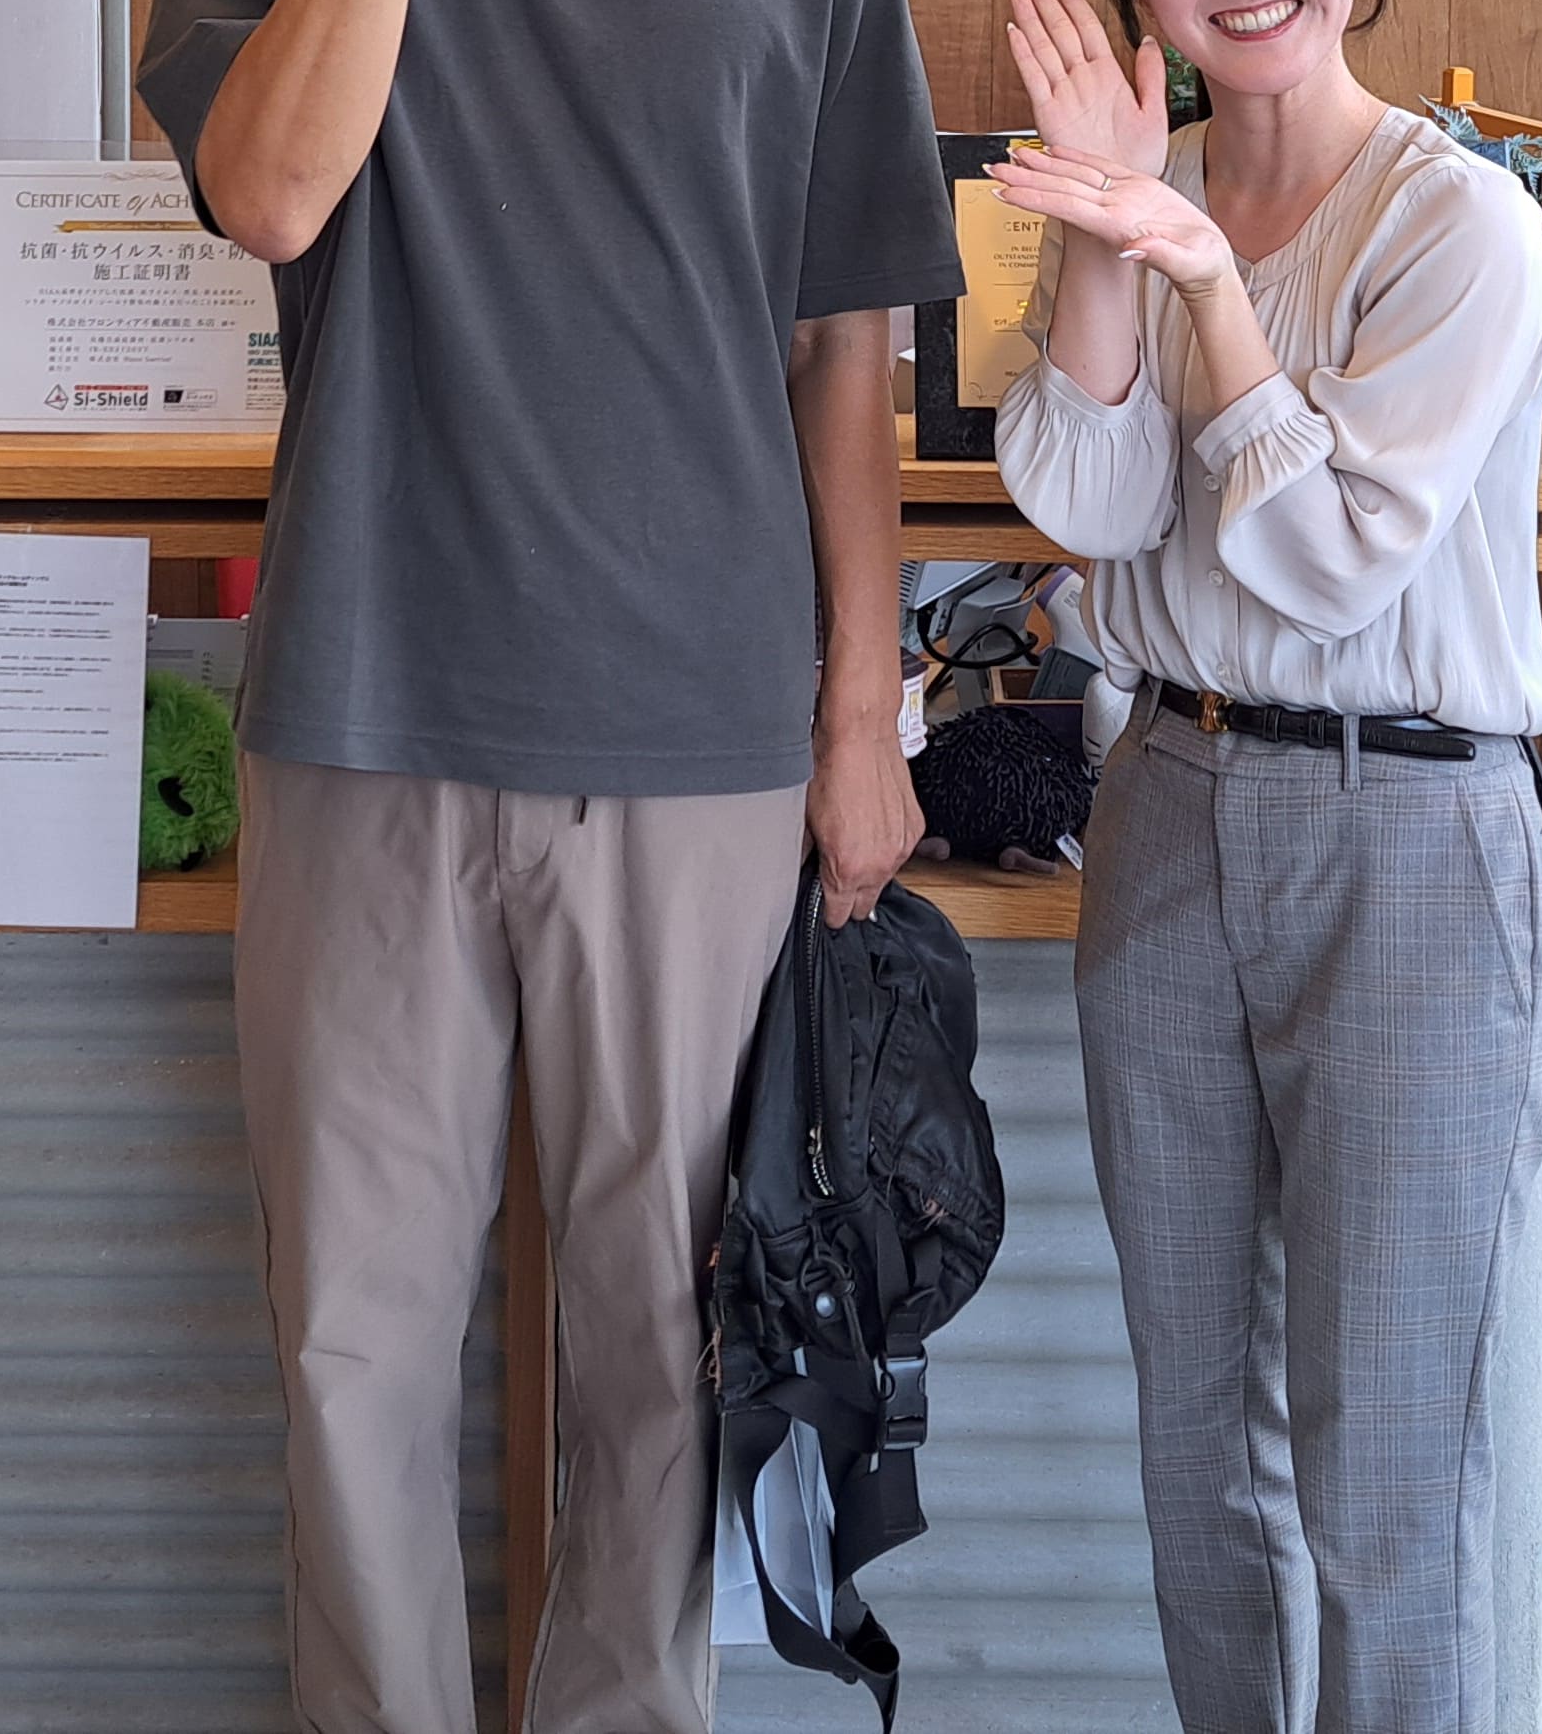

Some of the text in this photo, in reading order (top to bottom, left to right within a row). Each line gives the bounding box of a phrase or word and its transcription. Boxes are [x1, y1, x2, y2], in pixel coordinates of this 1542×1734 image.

[16, 192, 120, 209] CERTIFICATE
[1004, 221, 1045, 232] CENT
[94, 264, 191, 281] 施工証明書
[74, 391, 148, 407] Si-Shield
